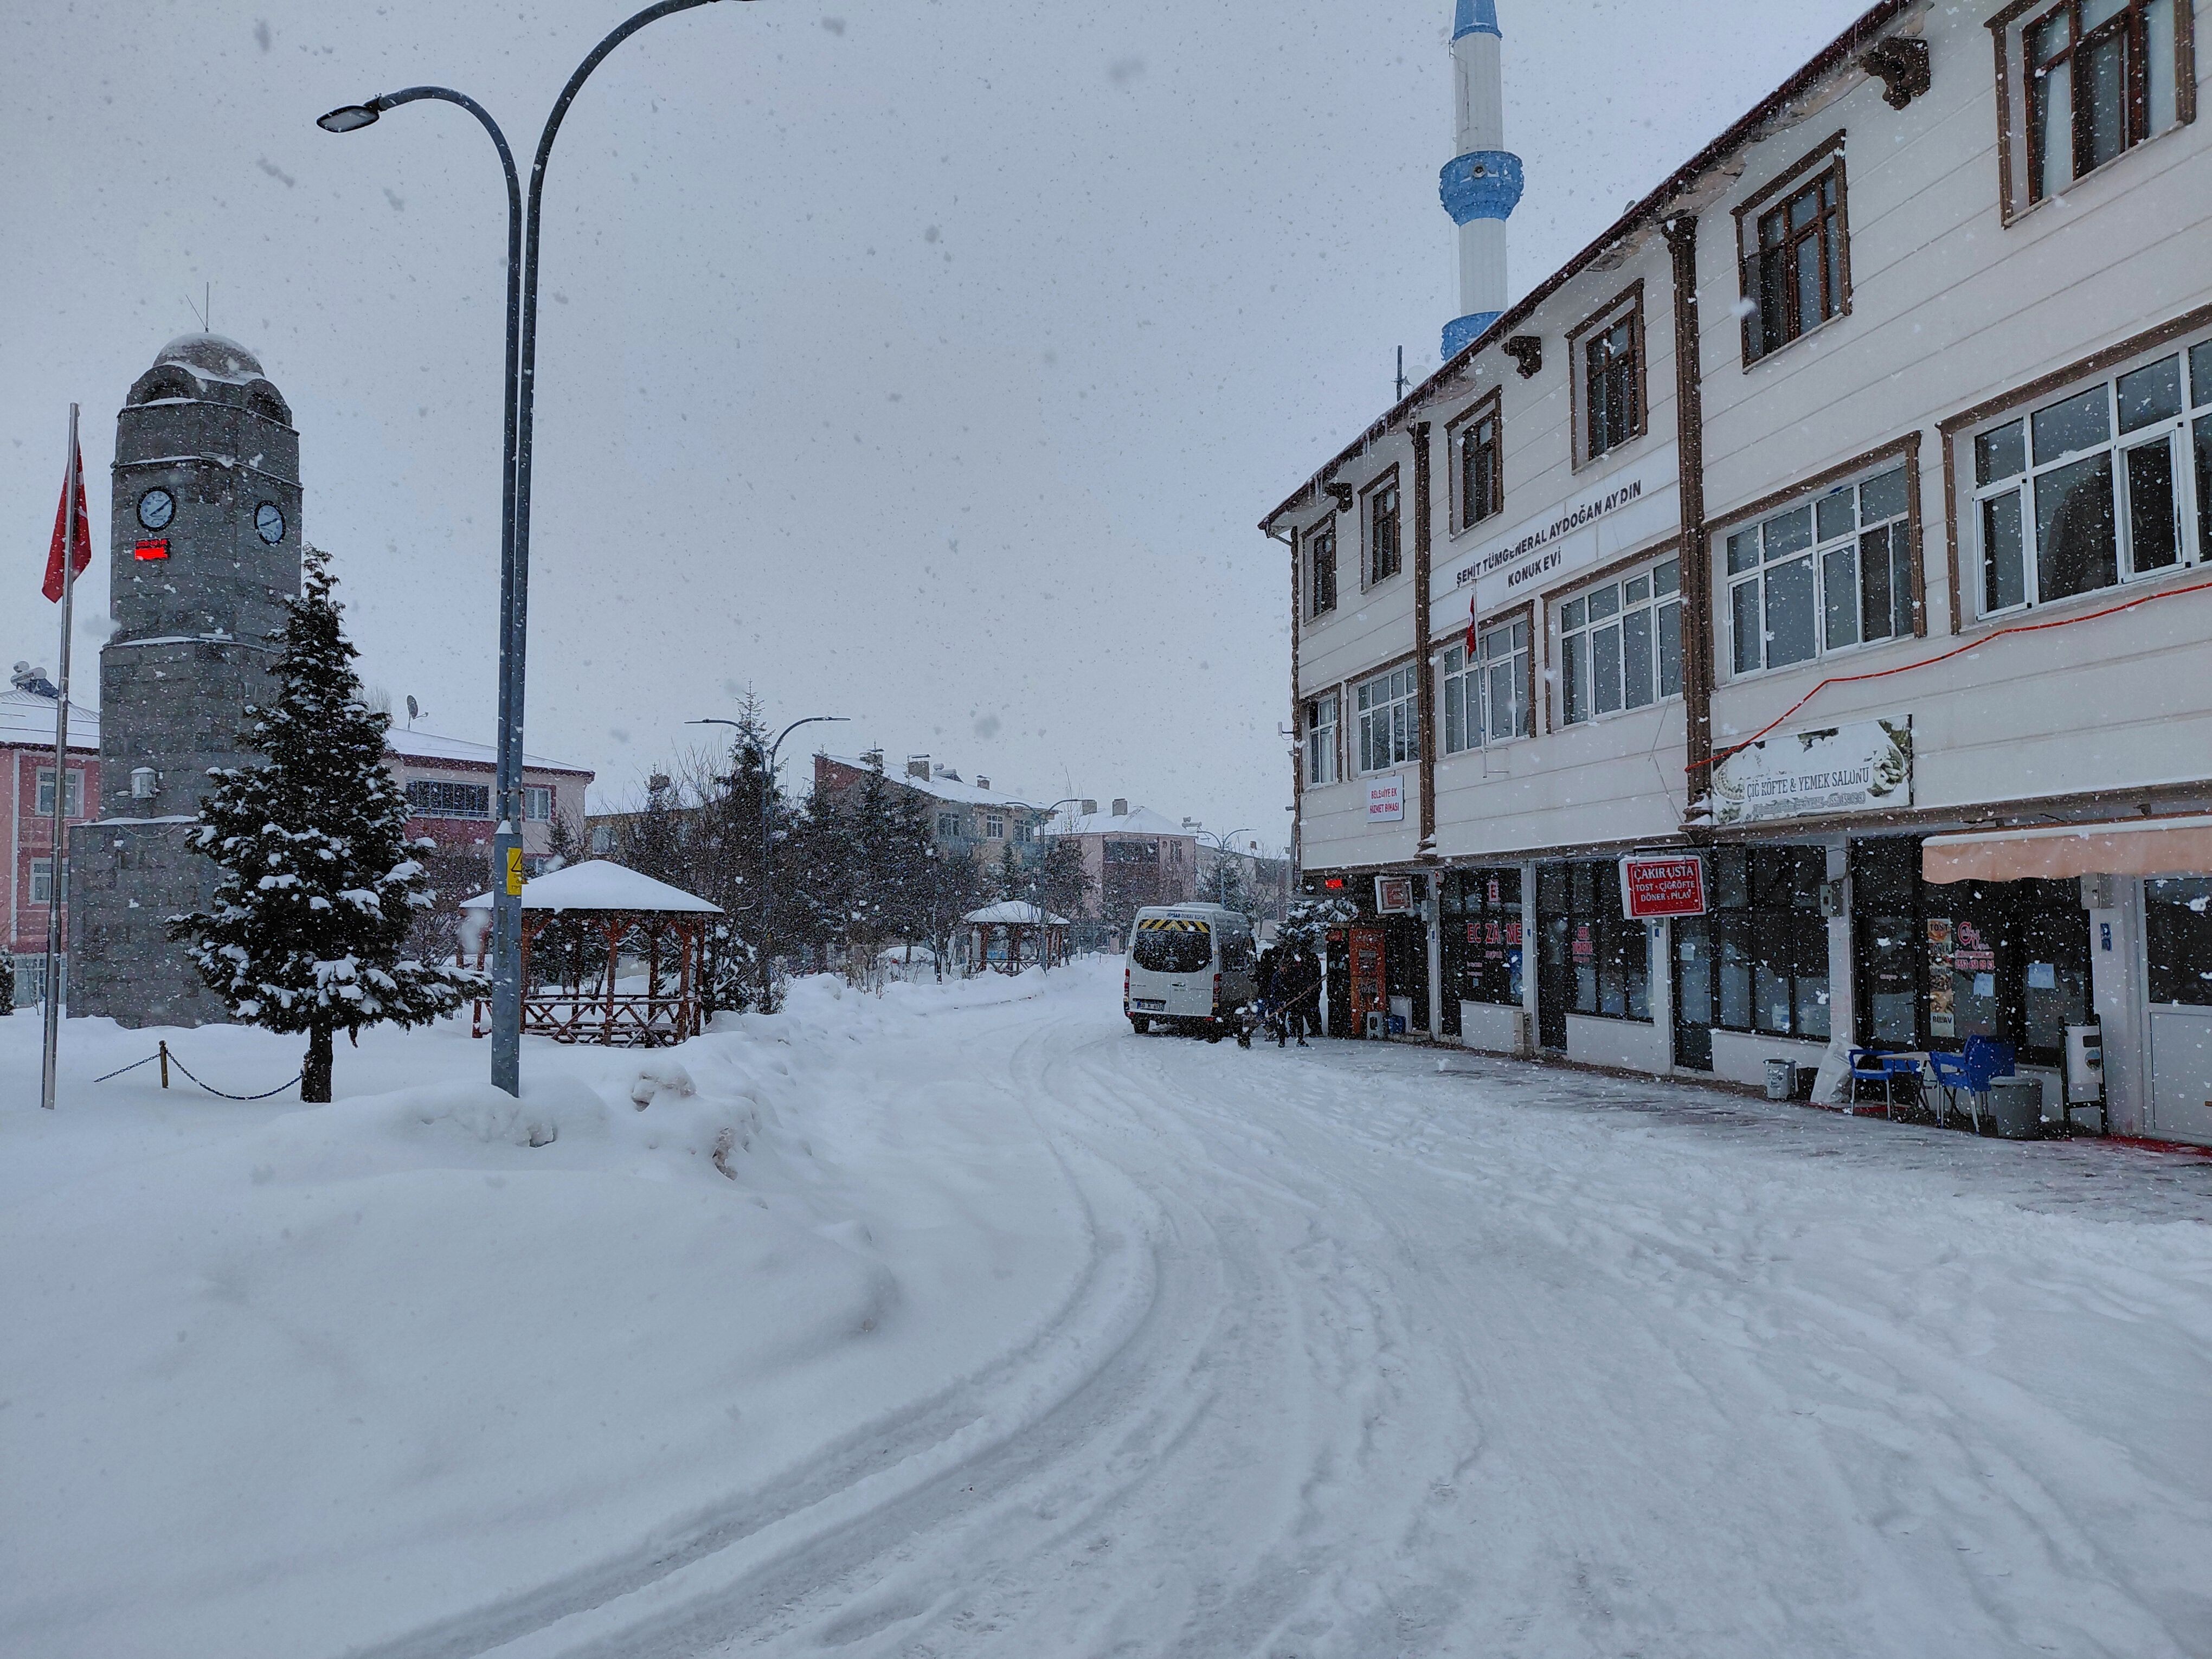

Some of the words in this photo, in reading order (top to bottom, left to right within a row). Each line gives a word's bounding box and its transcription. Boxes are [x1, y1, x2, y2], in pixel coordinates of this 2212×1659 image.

[1456, 561, 1482, 588] ŞEHİT
[1483, 529, 1547, 572] TÜMGENERAL
[1549, 499, 1603, 538] AYDOĞAN
[1604, 479, 1642, 512] AYDIN
[1508, 559, 1542, 588] KONUK
[1544, 545, 1562, 571] EVİ
[1391, 787, 1398, 797] EK
[1761, 777, 1788, 796] KÖFTE
[1790, 777, 1797, 792] &
[1798, 773, 1830, 792] YEMEK
[1634, 867, 1667, 883] ÇAKIR
[1668, 865, 1694, 879] USTA
[1635, 883, 1654, 892] TOST
[1641, 892, 1666, 902] DÖNER
[1670, 890, 1692, 900] PİLAV
[1930, 923, 1949, 931] TOST
